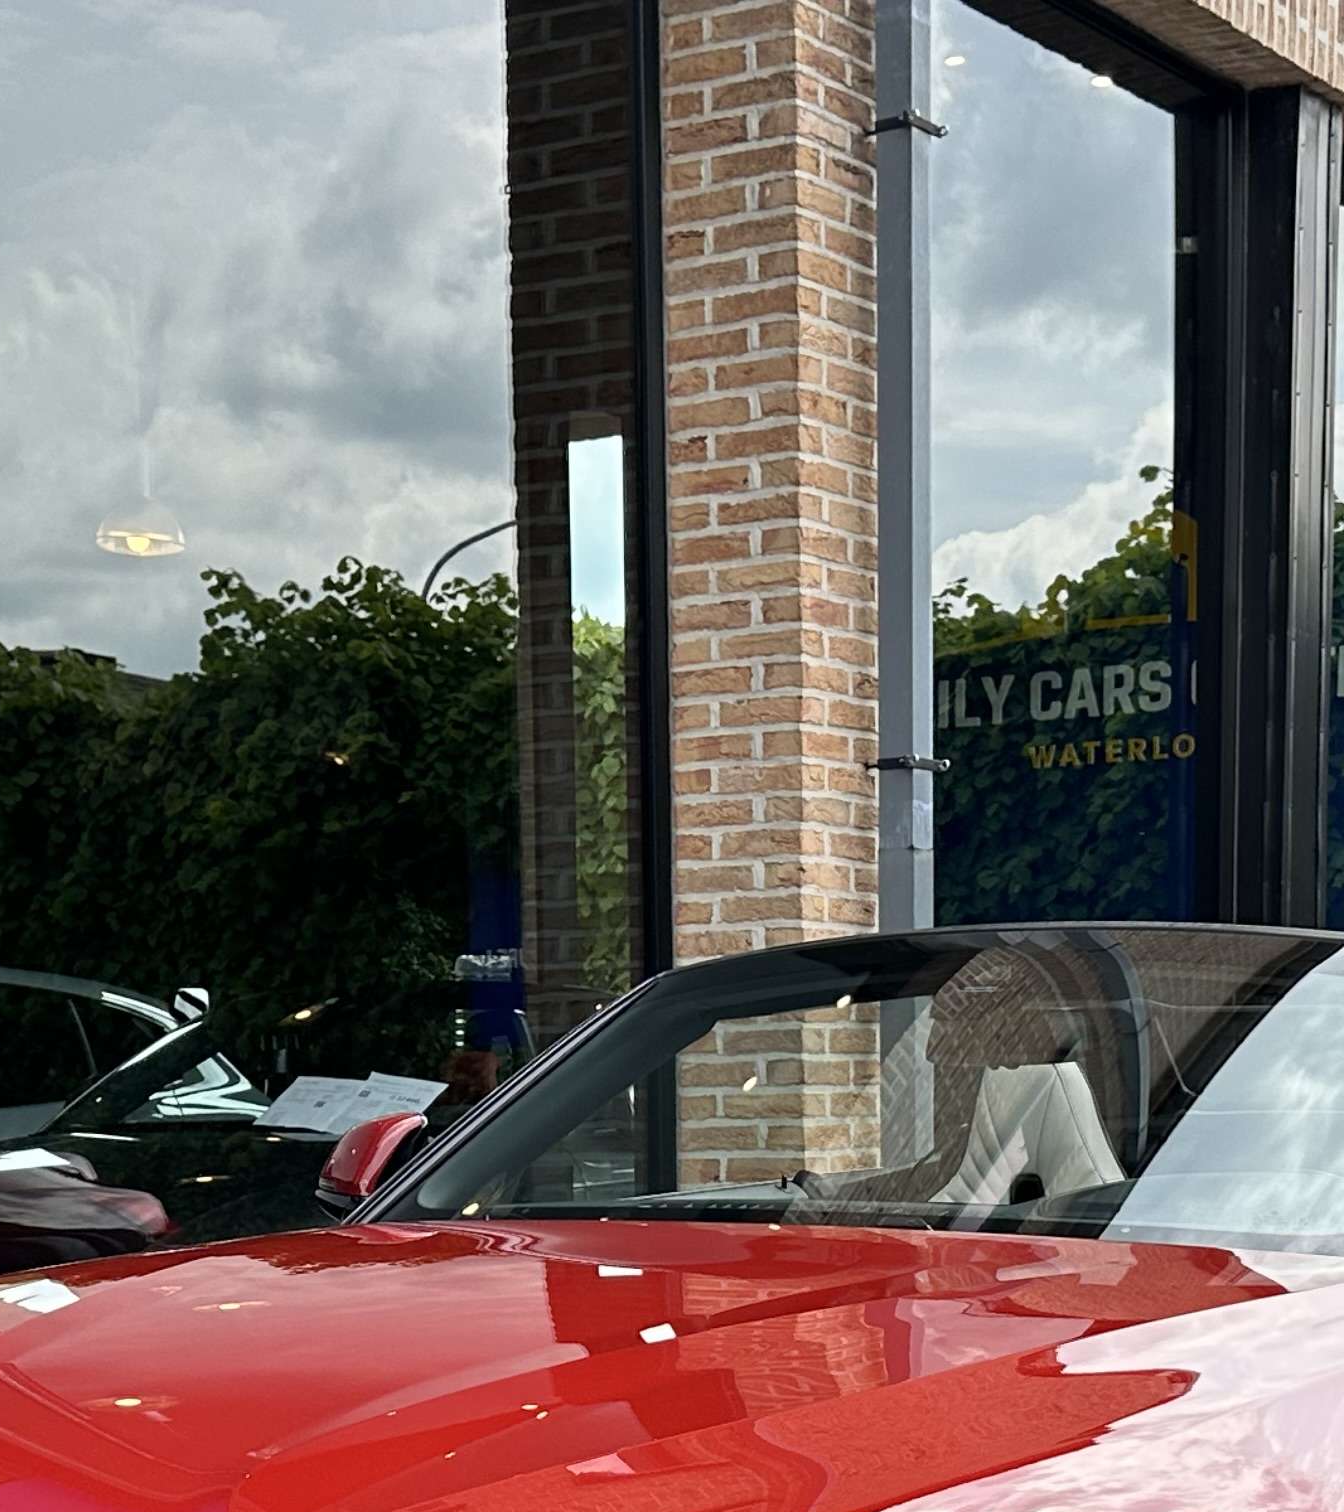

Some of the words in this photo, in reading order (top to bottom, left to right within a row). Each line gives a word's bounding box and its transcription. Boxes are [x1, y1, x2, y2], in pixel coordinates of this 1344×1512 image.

[937, 674, 1016, 728] ILY
[1030, 660, 1172, 721] CARS
[1029, 732, 1196, 769] WATERLO
